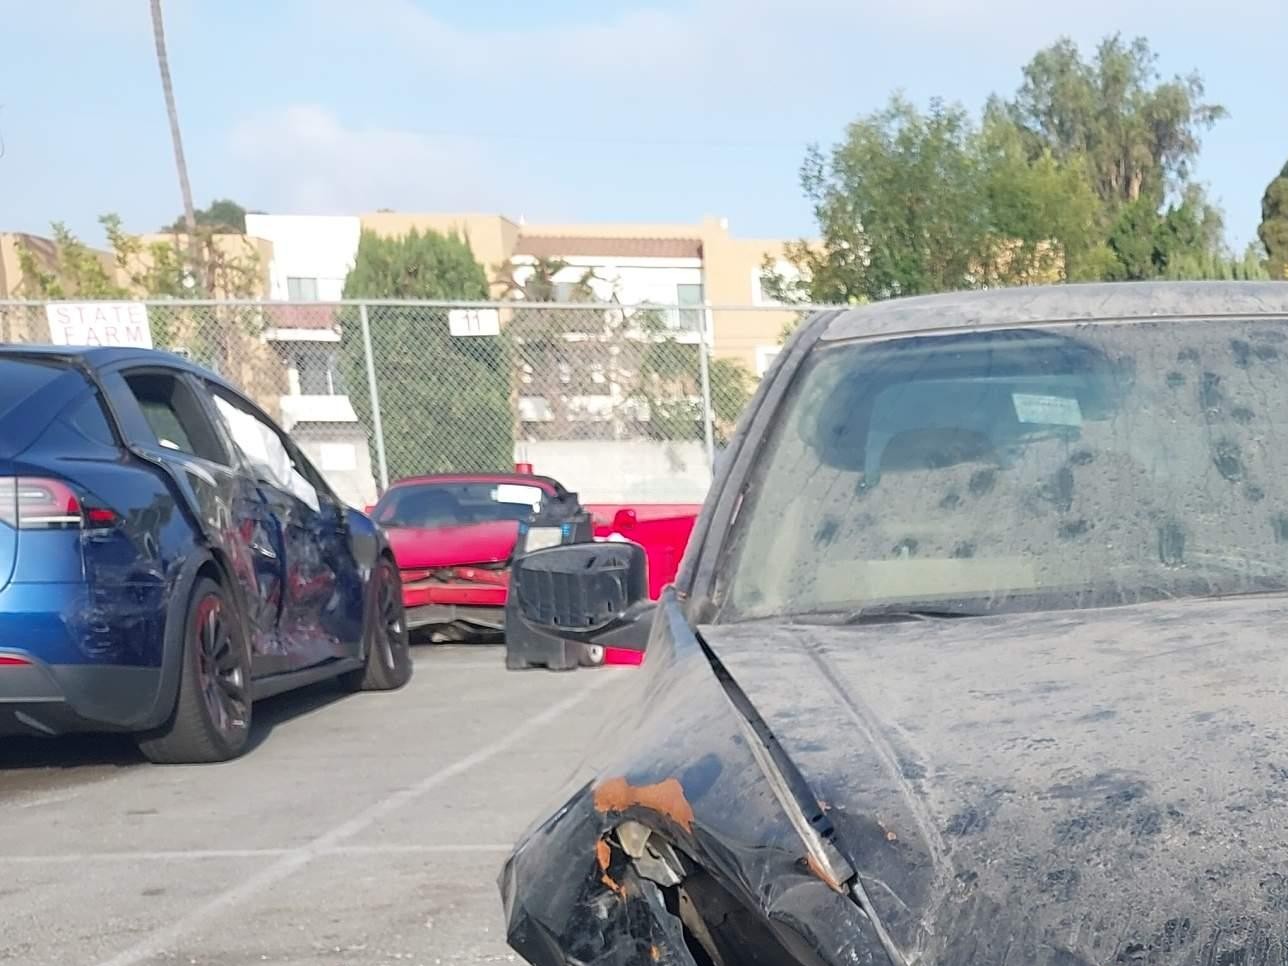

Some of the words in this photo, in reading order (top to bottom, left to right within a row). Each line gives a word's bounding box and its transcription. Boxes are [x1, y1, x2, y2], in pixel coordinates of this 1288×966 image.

[56, 305, 142, 324] STATE
[461, 311, 481, 331] 11
[64, 326, 144, 346] FARM
